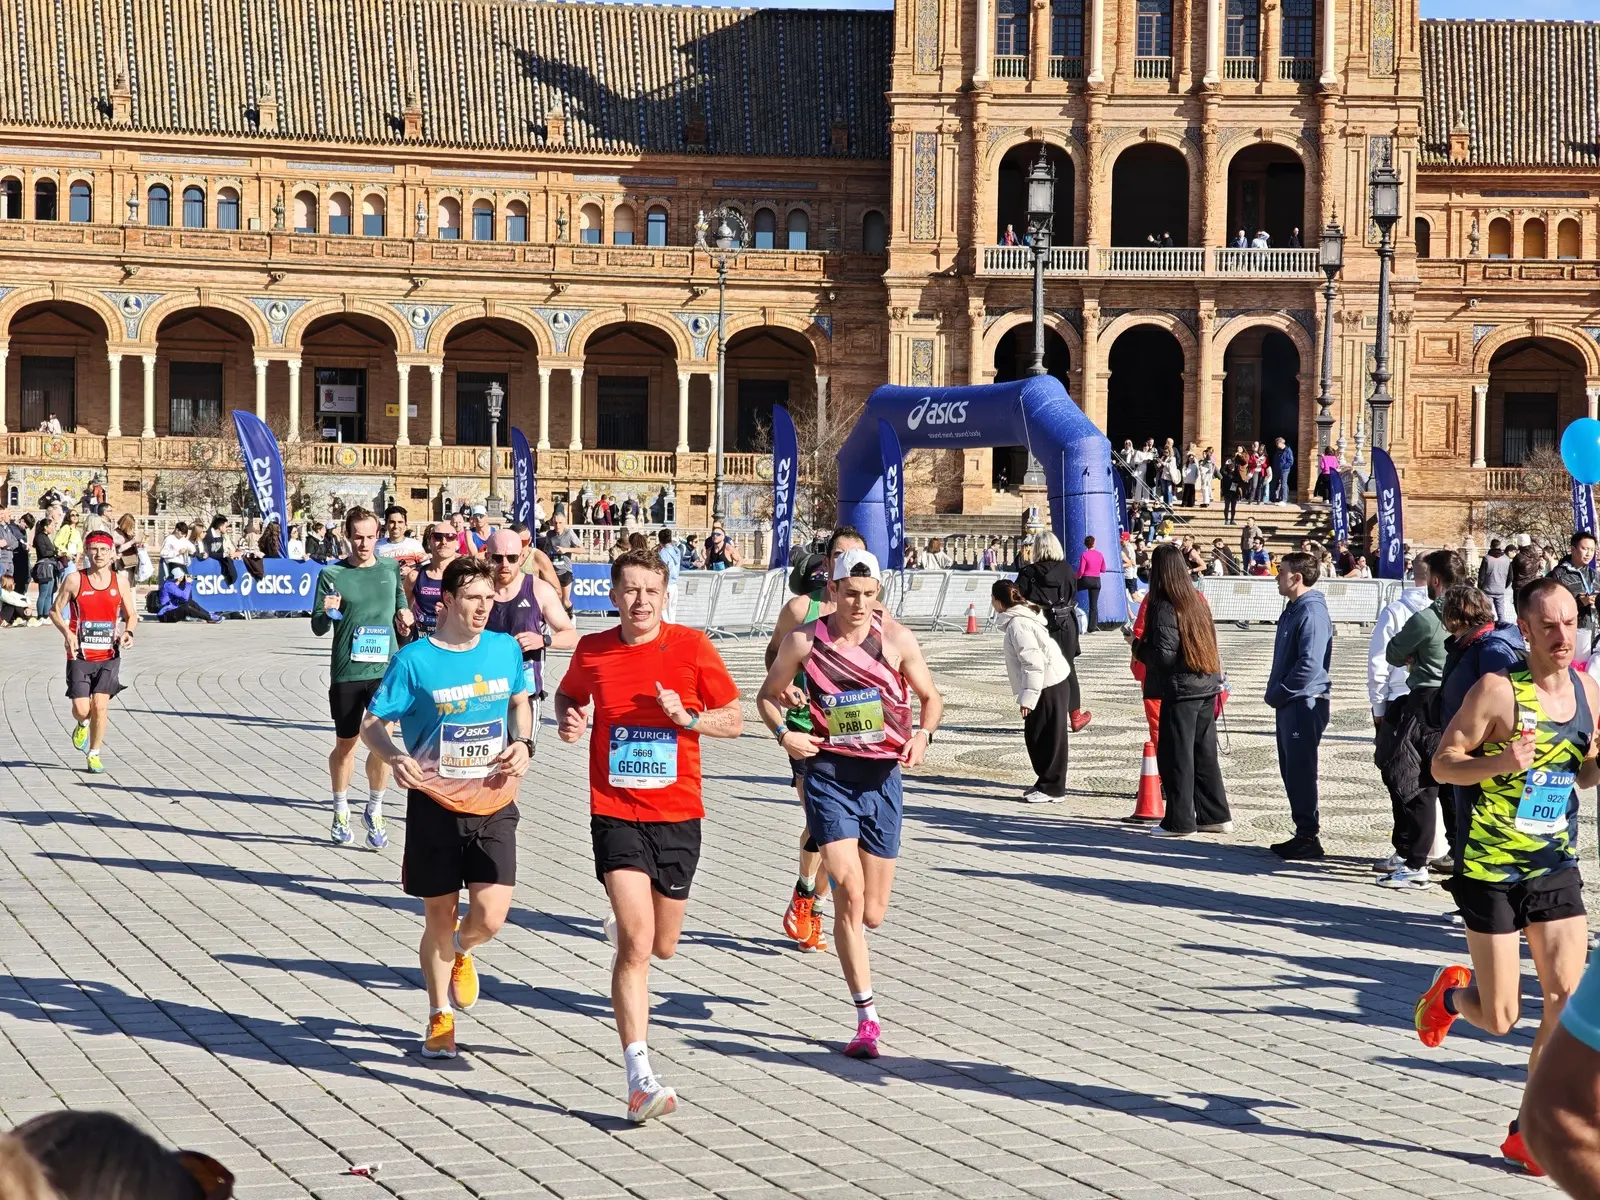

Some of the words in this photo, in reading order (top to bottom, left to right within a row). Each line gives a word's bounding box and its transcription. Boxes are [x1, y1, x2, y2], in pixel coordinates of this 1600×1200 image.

[926, 401, 969, 424] asics
[256, 575, 293, 595] asics
[574, 578, 611, 596] asics
[432, 674, 510, 703] IRONMAN
[840, 692, 873, 703] ZURICH
[436, 700, 466, 715] 70.3
[466, 726, 490, 736] asics
[839, 719, 873, 733] PABLO
[632, 731, 670, 740] ZURICH
[459, 744, 489, 757] 1976
[633, 748, 652, 757] 5669
[442, 756, 468, 767] SANTI
[618, 760, 667, 774] GEORGE
